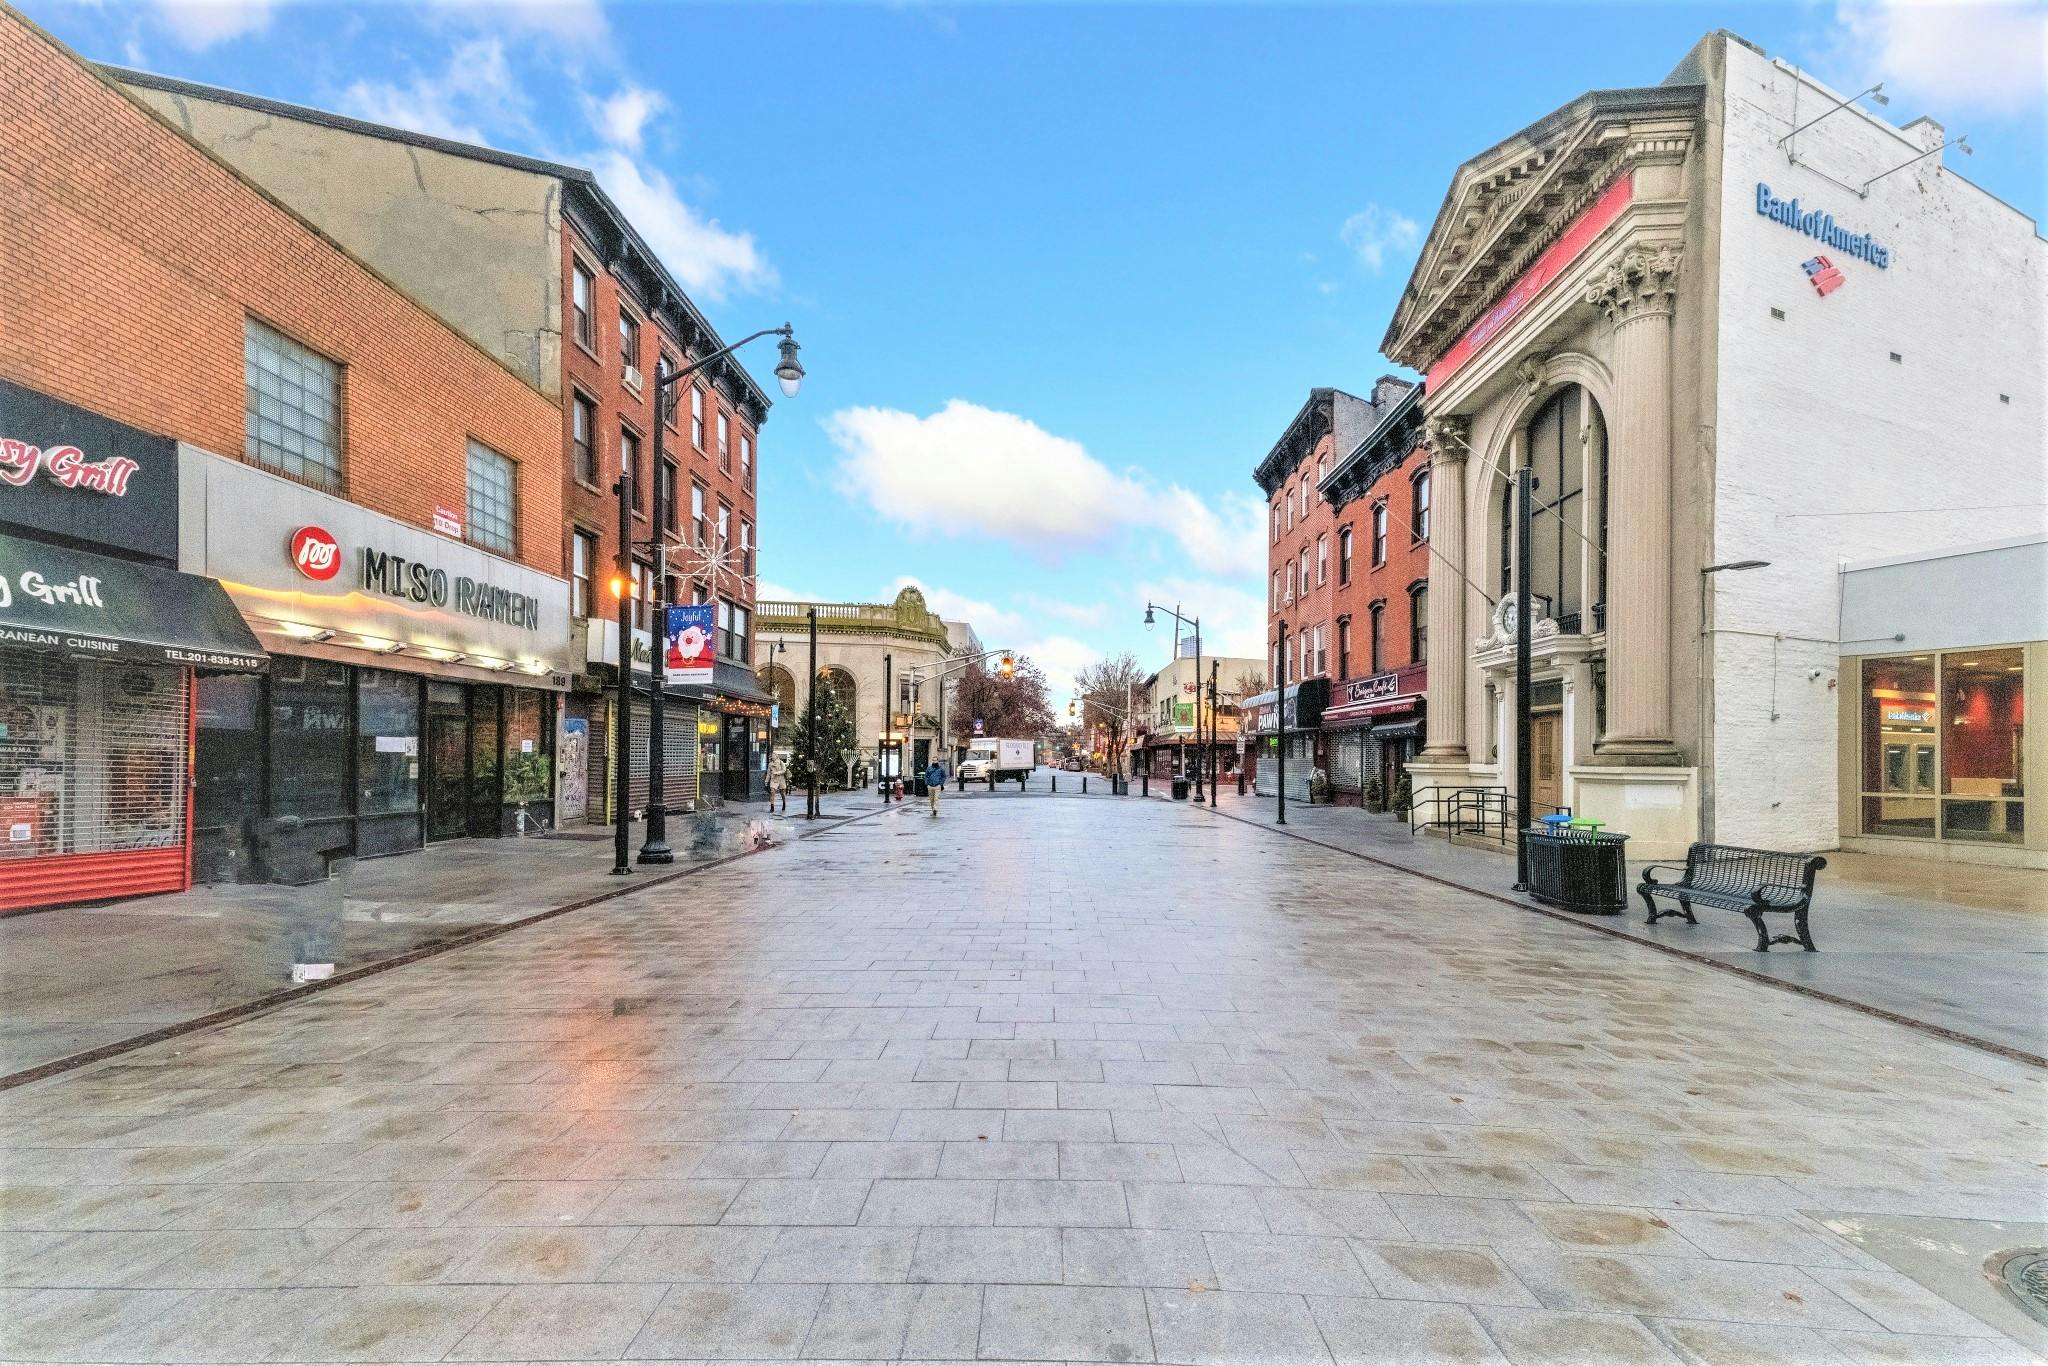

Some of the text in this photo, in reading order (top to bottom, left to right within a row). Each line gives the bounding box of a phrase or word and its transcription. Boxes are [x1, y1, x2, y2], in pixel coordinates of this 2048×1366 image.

[1821, 214, 1888, 269] America
[49, 446, 139, 496] Grill
[435, 504, 458, 520] Caution
[20, 571, 103, 608] Grill
[363, 547, 538, 631] MISO RAMEN
[681, 610, 701, 625] Joyful
[66, 638, 119, 652] CUISINE
[552, 676, 566, 686] 189
